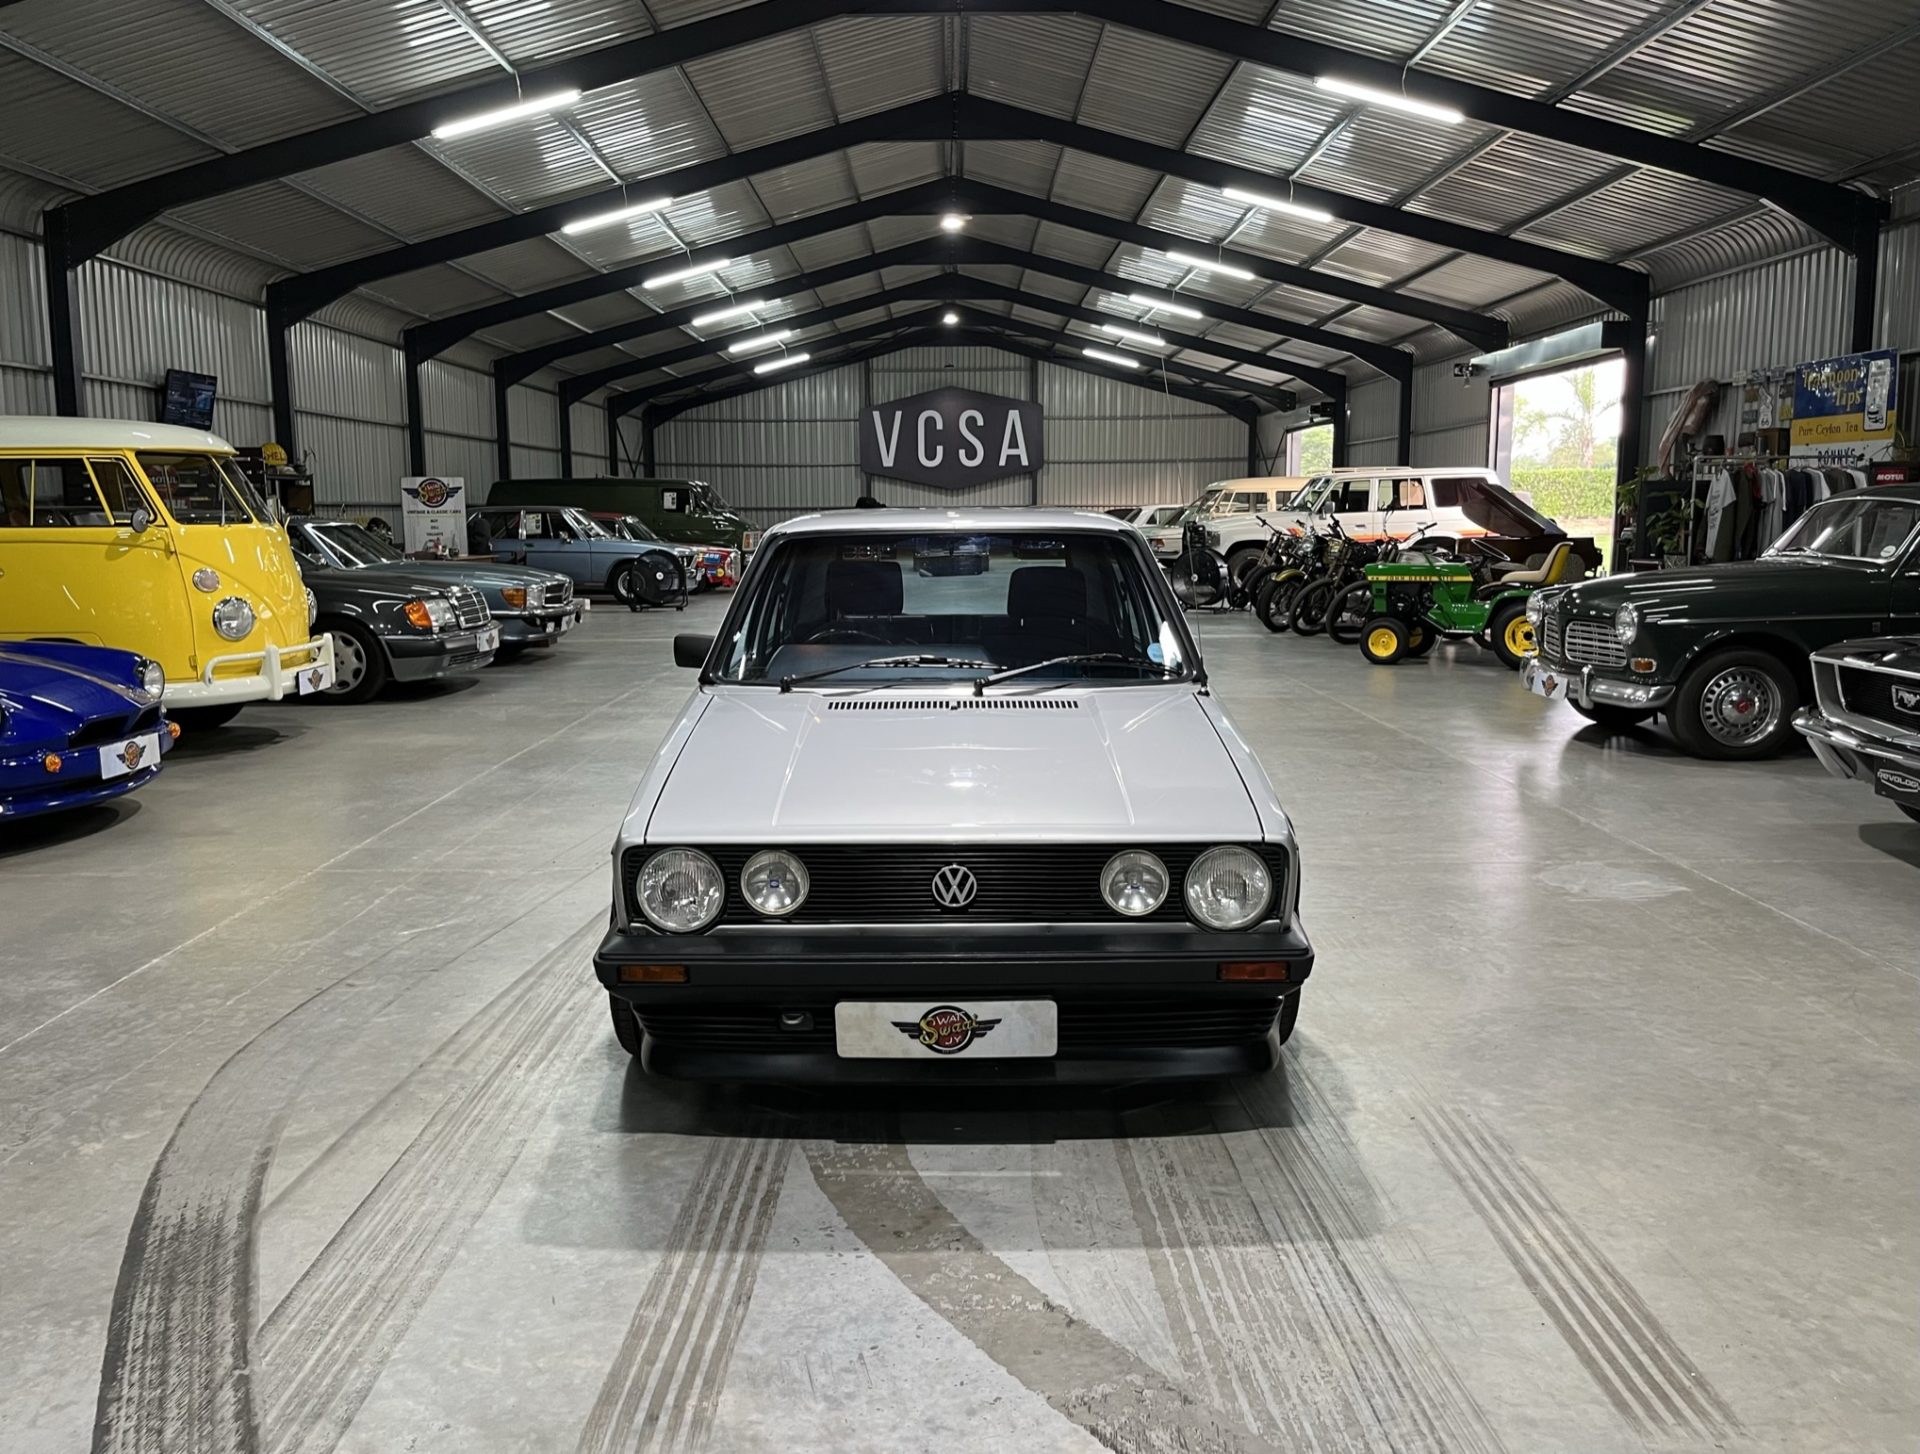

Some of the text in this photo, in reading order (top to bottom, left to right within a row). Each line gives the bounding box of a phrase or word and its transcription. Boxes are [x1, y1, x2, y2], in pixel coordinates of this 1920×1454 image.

[1803, 368, 1858, 391] Teaspoon
[1834, 389, 1861, 411] Tips
[872, 409, 1029, 468] VCSA
[1798, 421, 1858, 437] Pure Ceylon Tea
[1876, 473, 1904, 481] MOTUL
[945, 1035, 961, 1045] JY
